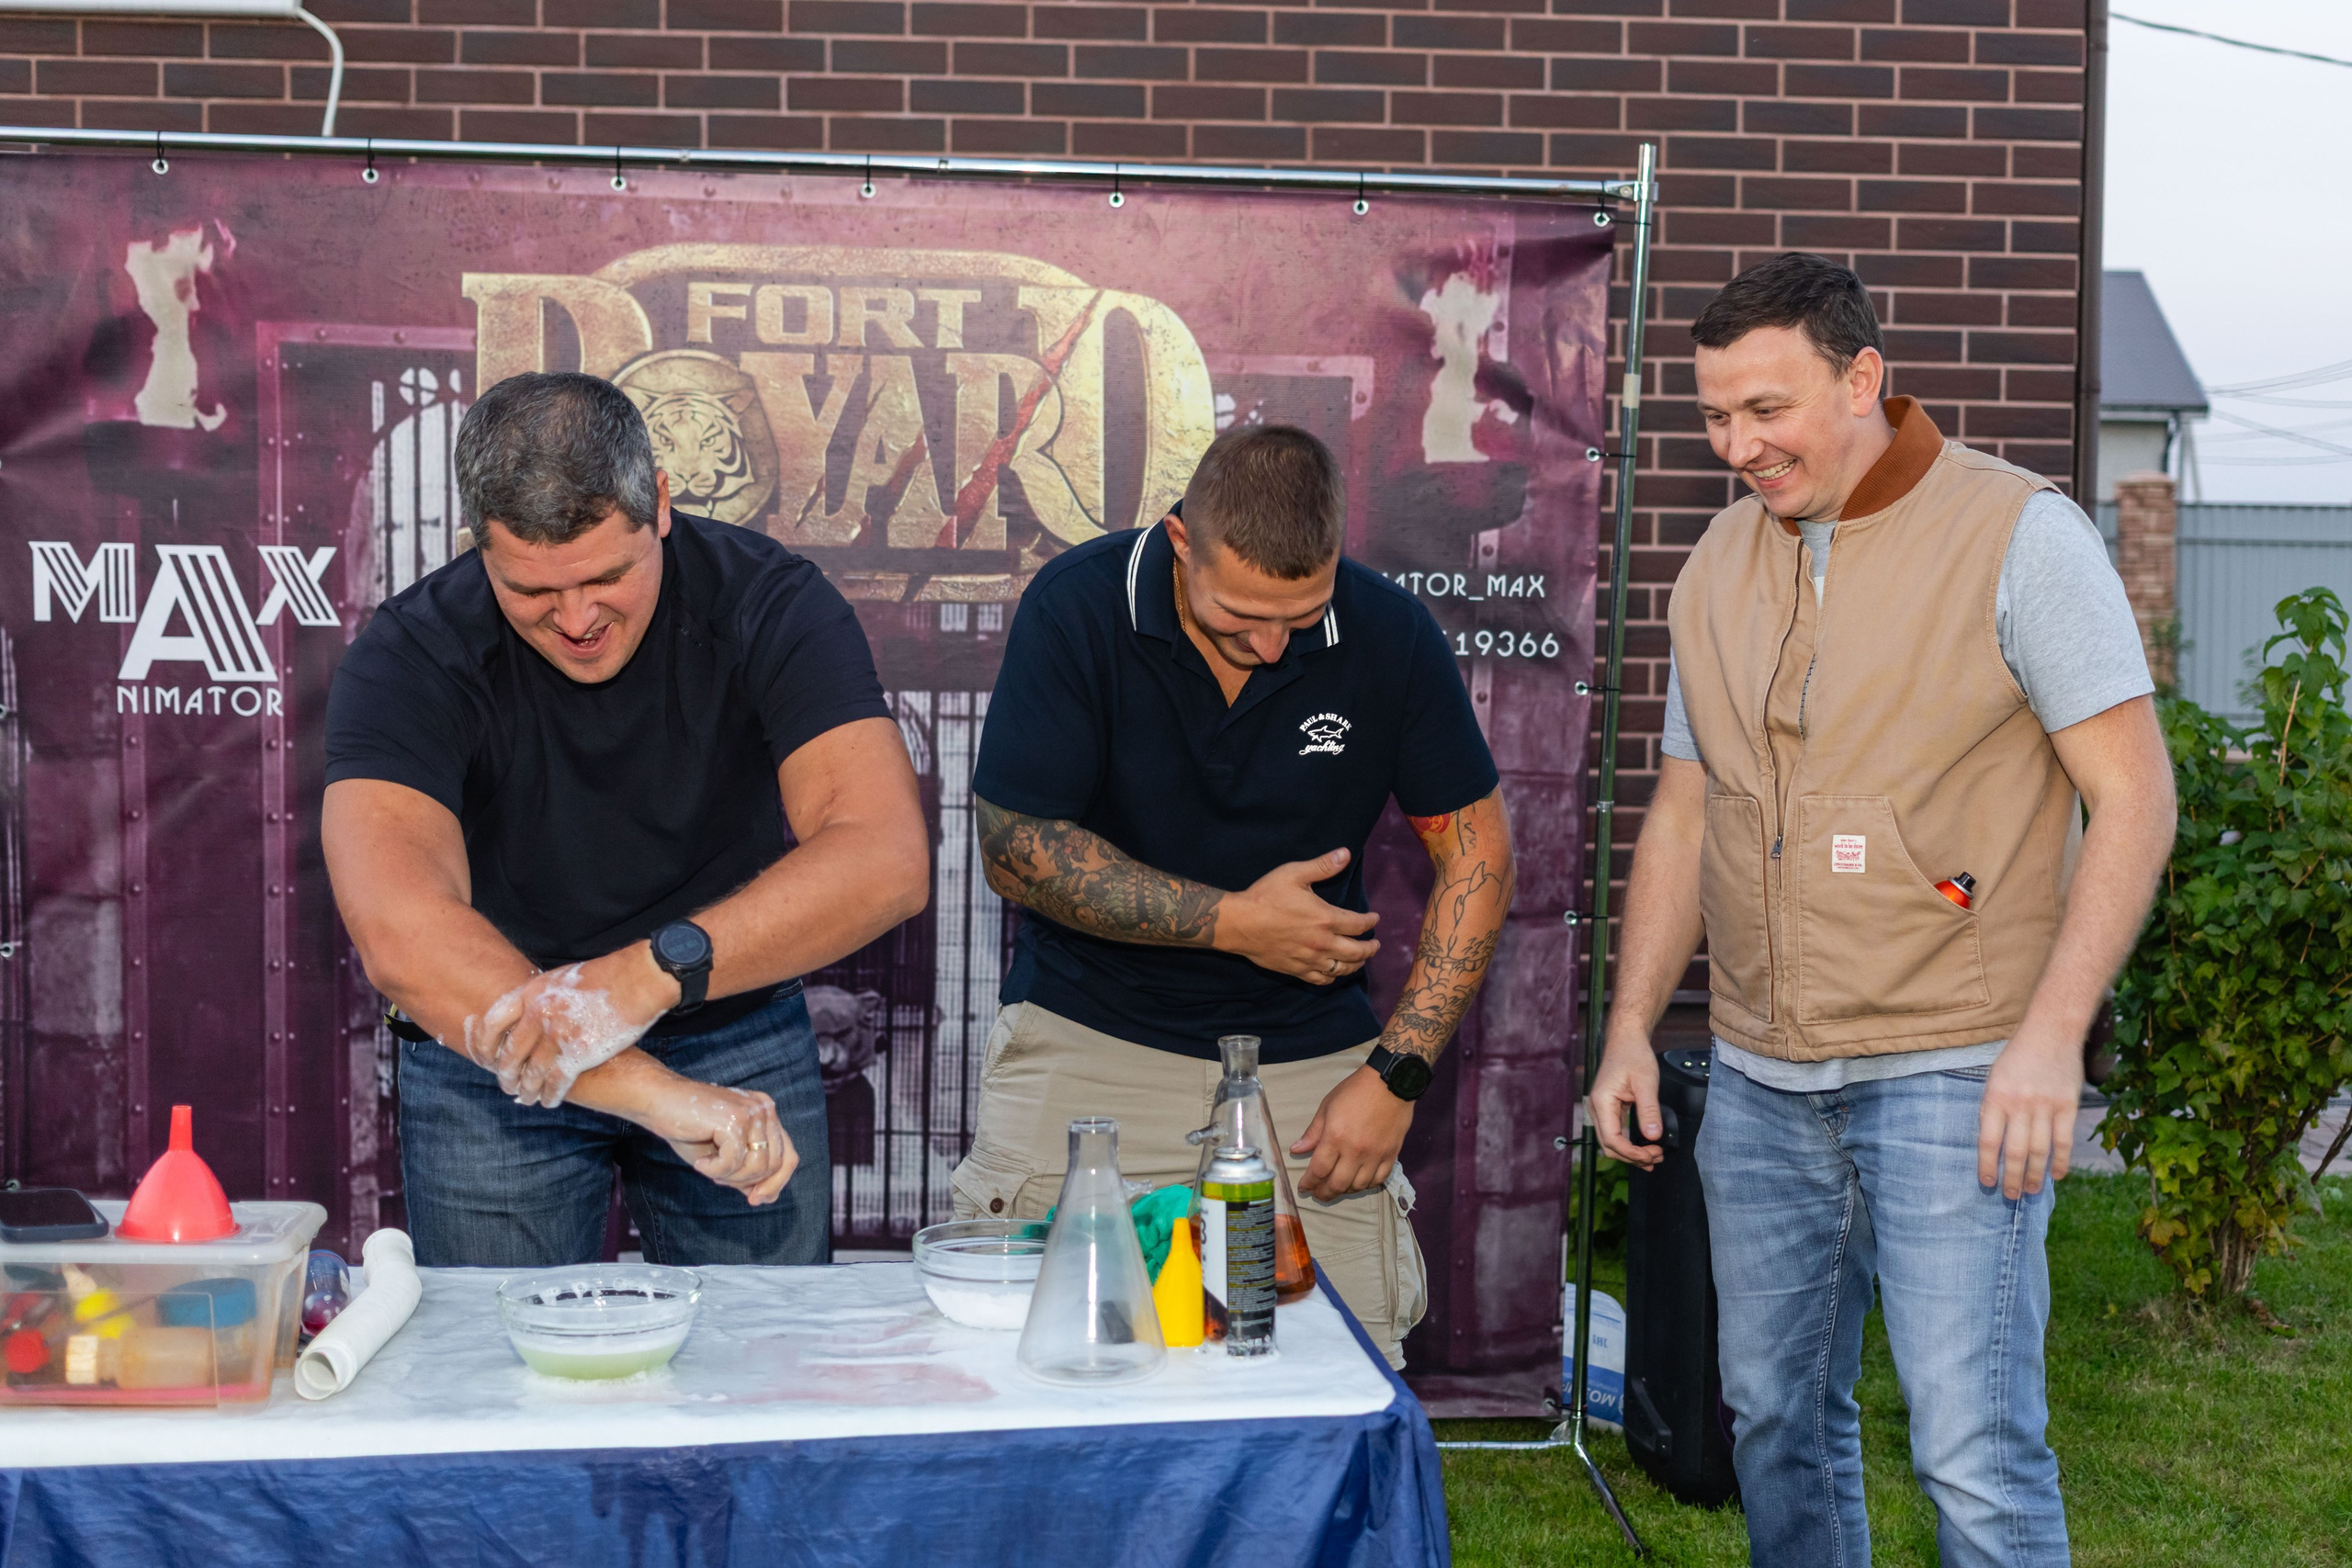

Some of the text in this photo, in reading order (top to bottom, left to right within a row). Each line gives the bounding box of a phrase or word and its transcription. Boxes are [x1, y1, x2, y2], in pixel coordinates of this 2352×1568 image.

[686, 281, 981, 349] FORT
[28, 540, 341, 682] MAX
[1442, 630, 1559, 658] 19366
[117, 685, 284, 716] NIMATOR
[1299, 716, 1318, 732] PAUL
[1325, 713, 1352, 731] SHARK
[1298, 739, 1345, 755] yachting
